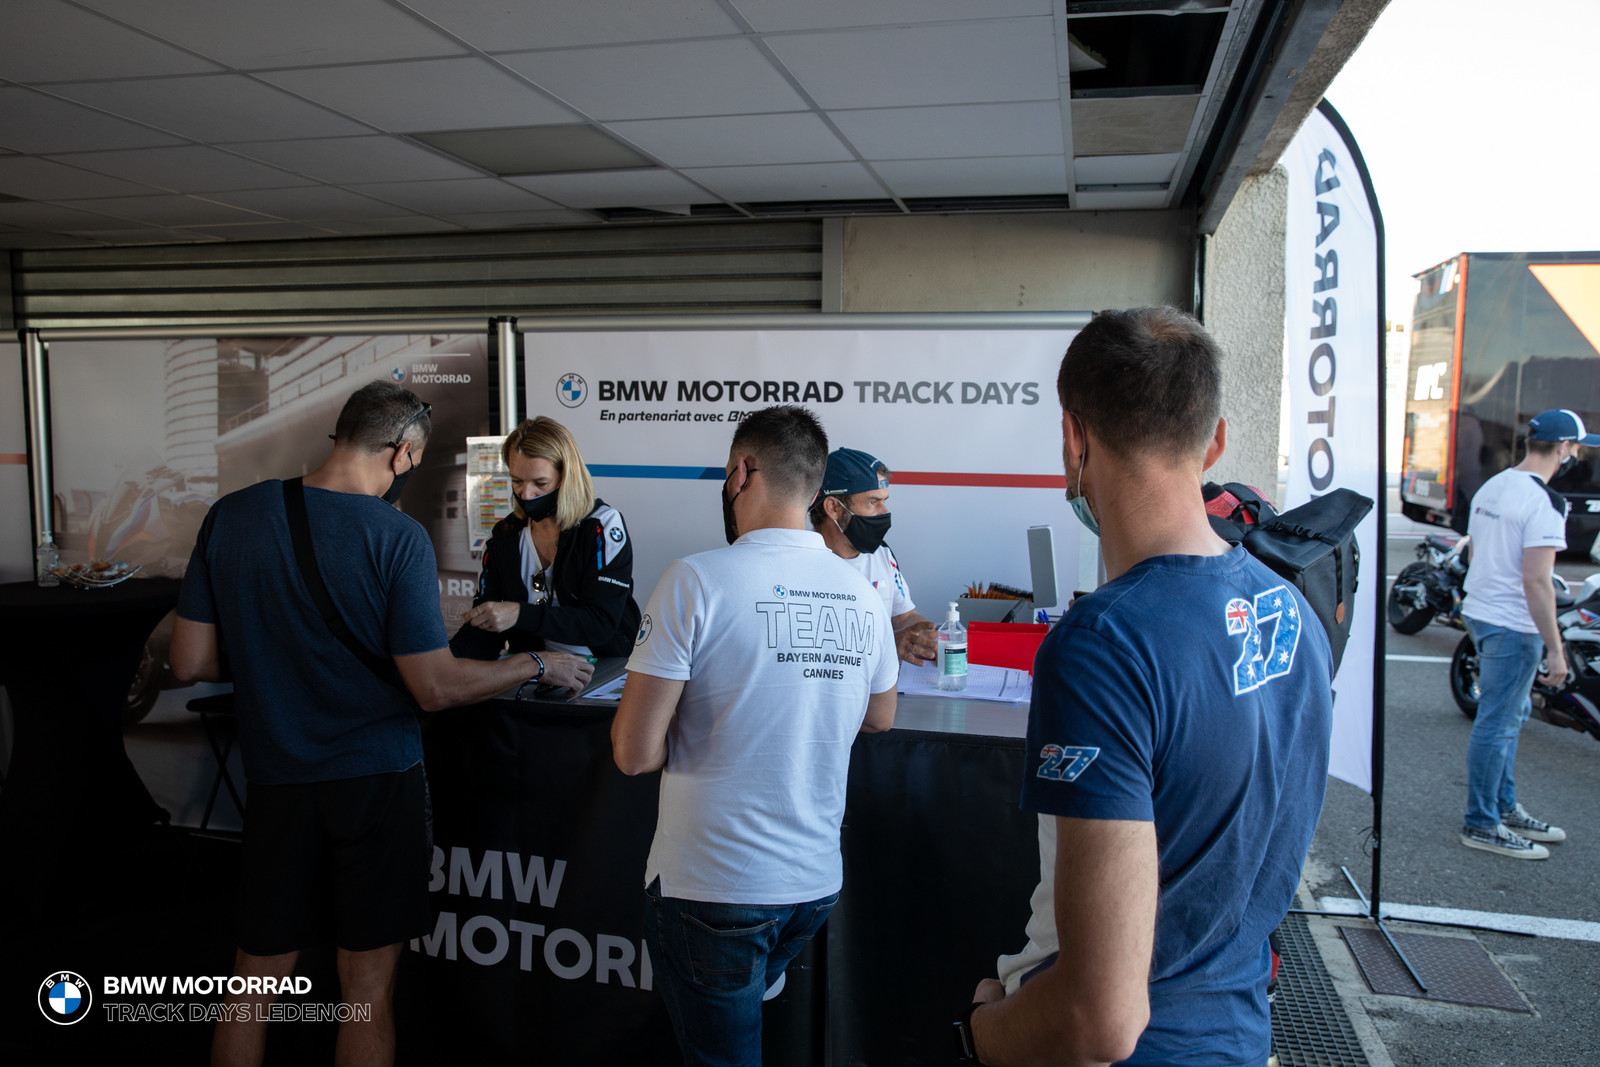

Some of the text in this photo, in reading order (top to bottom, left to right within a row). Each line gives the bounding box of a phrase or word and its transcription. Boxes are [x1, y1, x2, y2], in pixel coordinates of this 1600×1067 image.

[411, 363, 438, 373] BMW
[411, 374, 472, 384] MOTORRAD
[598, 380, 1040, 405] BMW MOTORRAD TRACK DAYS
[599, 409, 616, 421] En
[618, 409, 691, 423] partenariat
[693, 413, 724, 422] avec
[447, 578, 476, 597] RR
[789, 589, 857, 602] BMW MOTORRAD
[755, 601, 875, 656] TEAM
[1224, 584, 1302, 697] 27
[776, 652, 862, 667] BAYERN AVENUE
[802, 668, 844, 680] CANNES
[1036, 743, 1101, 783] 27
[427, 844, 568, 909] BMW
